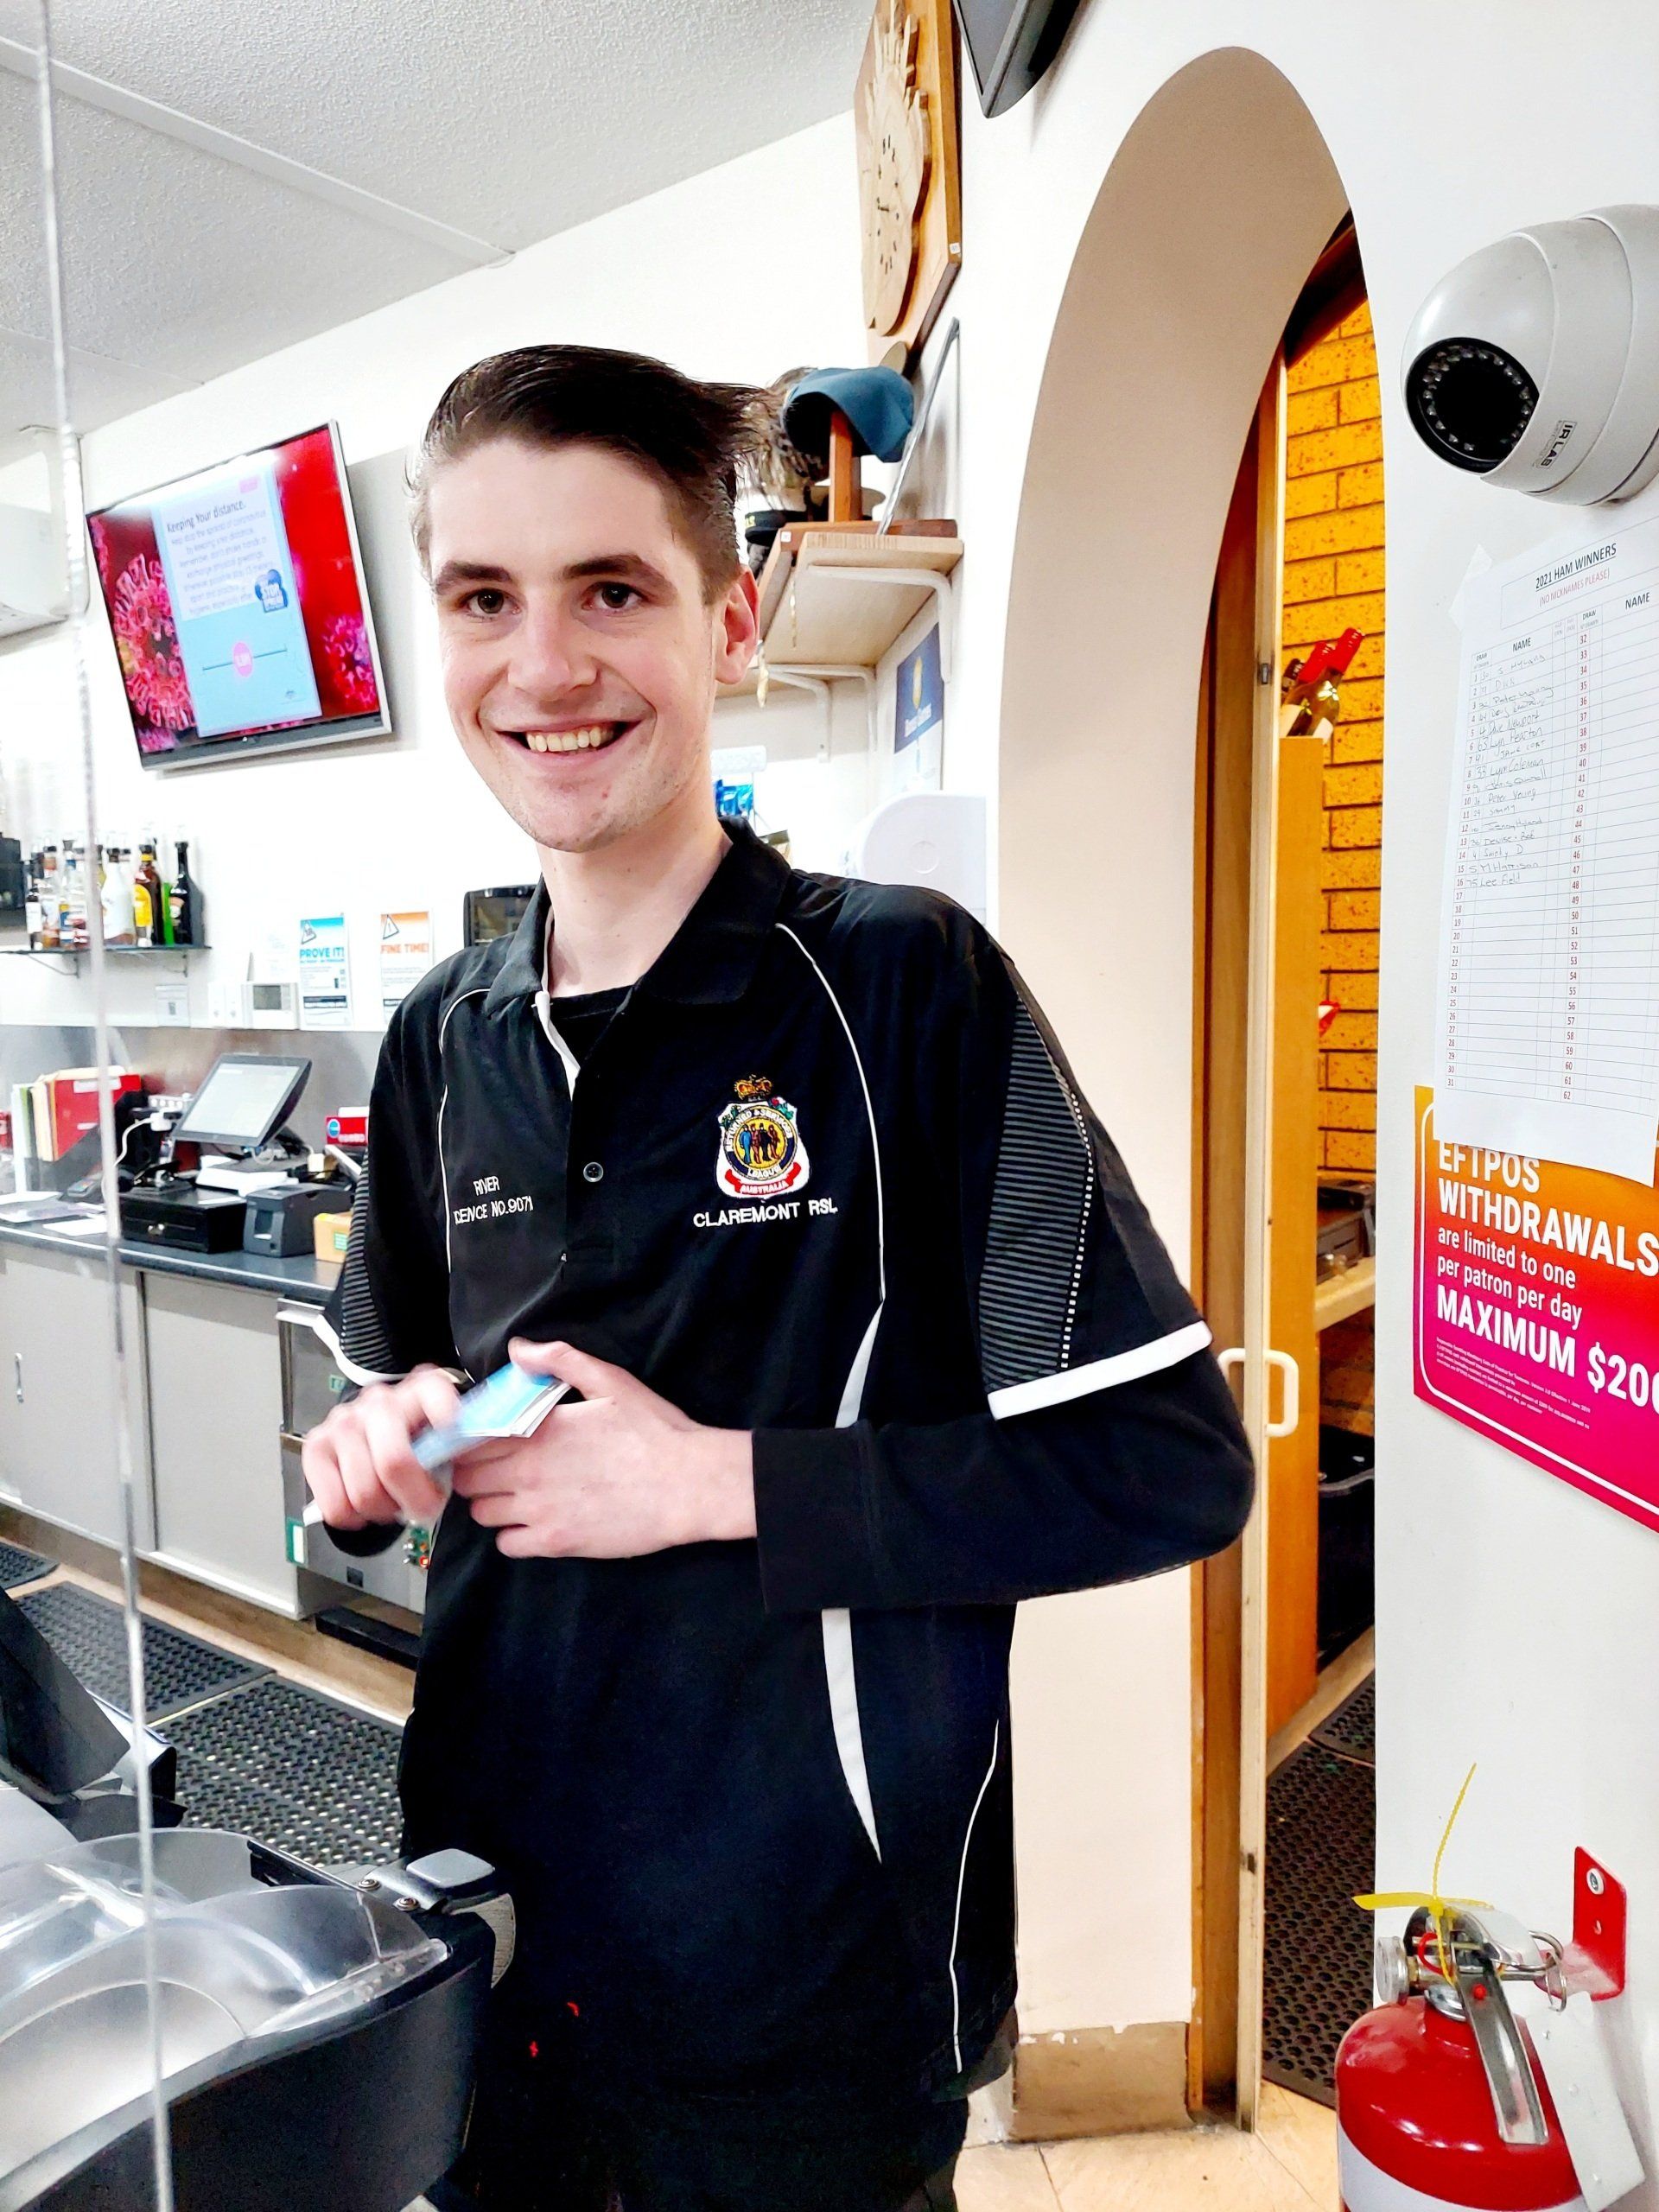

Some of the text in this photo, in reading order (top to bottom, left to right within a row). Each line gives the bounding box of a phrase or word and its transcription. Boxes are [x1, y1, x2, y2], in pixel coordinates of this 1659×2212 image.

[1541, 424, 1573, 467] IRLAB
[1535, 543, 1617, 589] 2021 HAM WINNERS
[1550, 582, 1584, 601] NICKNAMES
[1585, 568, 1610, 586] PLEASE)
[1625, 592, 1650, 610] NAME
[1583, 609, 1596, 620] DRAW
[1580, 634, 1587, 644] 32
[1512, 637, 1531, 652] NAME
[1580, 650, 1587, 660] 33
[1580, 665, 1587, 676] 34
[1580, 681, 1587, 690] 35
[1580, 696, 1587, 707] 36
[1580, 712, 1587, 721] 37
[1580, 727, 1587, 737] 38
[1580, 742, 1587, 753] 39
[1579, 758, 1586, 768] 40
[1578, 774, 1586, 783] 41
[1577, 789, 1585, 798] 42
[1465, 797, 1471, 805] 10
[1576, 804, 1584, 813] 43
[1460, 837, 1467, 846] 13
[1573, 835, 1581, 843] 45
[1459, 851, 1466, 860] 14
[1573, 850, 1580, 860] 46
[1458, 865, 1465, 874] 15
[1572, 866, 1580, 874] 47
[1572, 880, 1580, 890] 48
[1455, 905, 1462, 913] 18
[1571, 911, 1579, 920] 50
[1454, 918, 1461, 927] 19
[1571, 926, 1579, 935] 51
[380, 944, 402, 954] FINE
[1452, 945, 1459, 954] 21
[1571, 941, 1578, 950] 52
[300, 946, 345, 958] PROVE IT!
[1570, 957, 1578, 965] 53
[1569, 971, 1577, 980] 54
[1568, 987, 1576, 995] 55
[1568, 1001, 1576, 1010] 56
[1449, 1012, 1456, 1020] 26
[1567, 1016, 1575, 1025] 57
[1567, 1032, 1574, 1040] 58
[1566, 1046, 1573, 1055] 59
[1448, 1052, 1455, 1060] 29
[1565, 1061, 1573, 1071] 60
[1564, 1076, 1572, 1085] 61
[1563, 1091, 1571, 1100] 62
[1439, 1141, 1540, 1193] EFTPOS
[473, 1176, 499, 1196] RIVER
[740, 1180, 790, 1194] AUSTRALIA
[693, 1198, 838, 1228] CLAREMONT RSL
[1438, 1178, 1659, 1277] WITHDRAWALS
[1438, 1227, 1576, 1289] are limited to one
[1437, 1255, 1582, 1331] per patron per day
[1437, 1284, 1576, 1378] MAXIMUM
